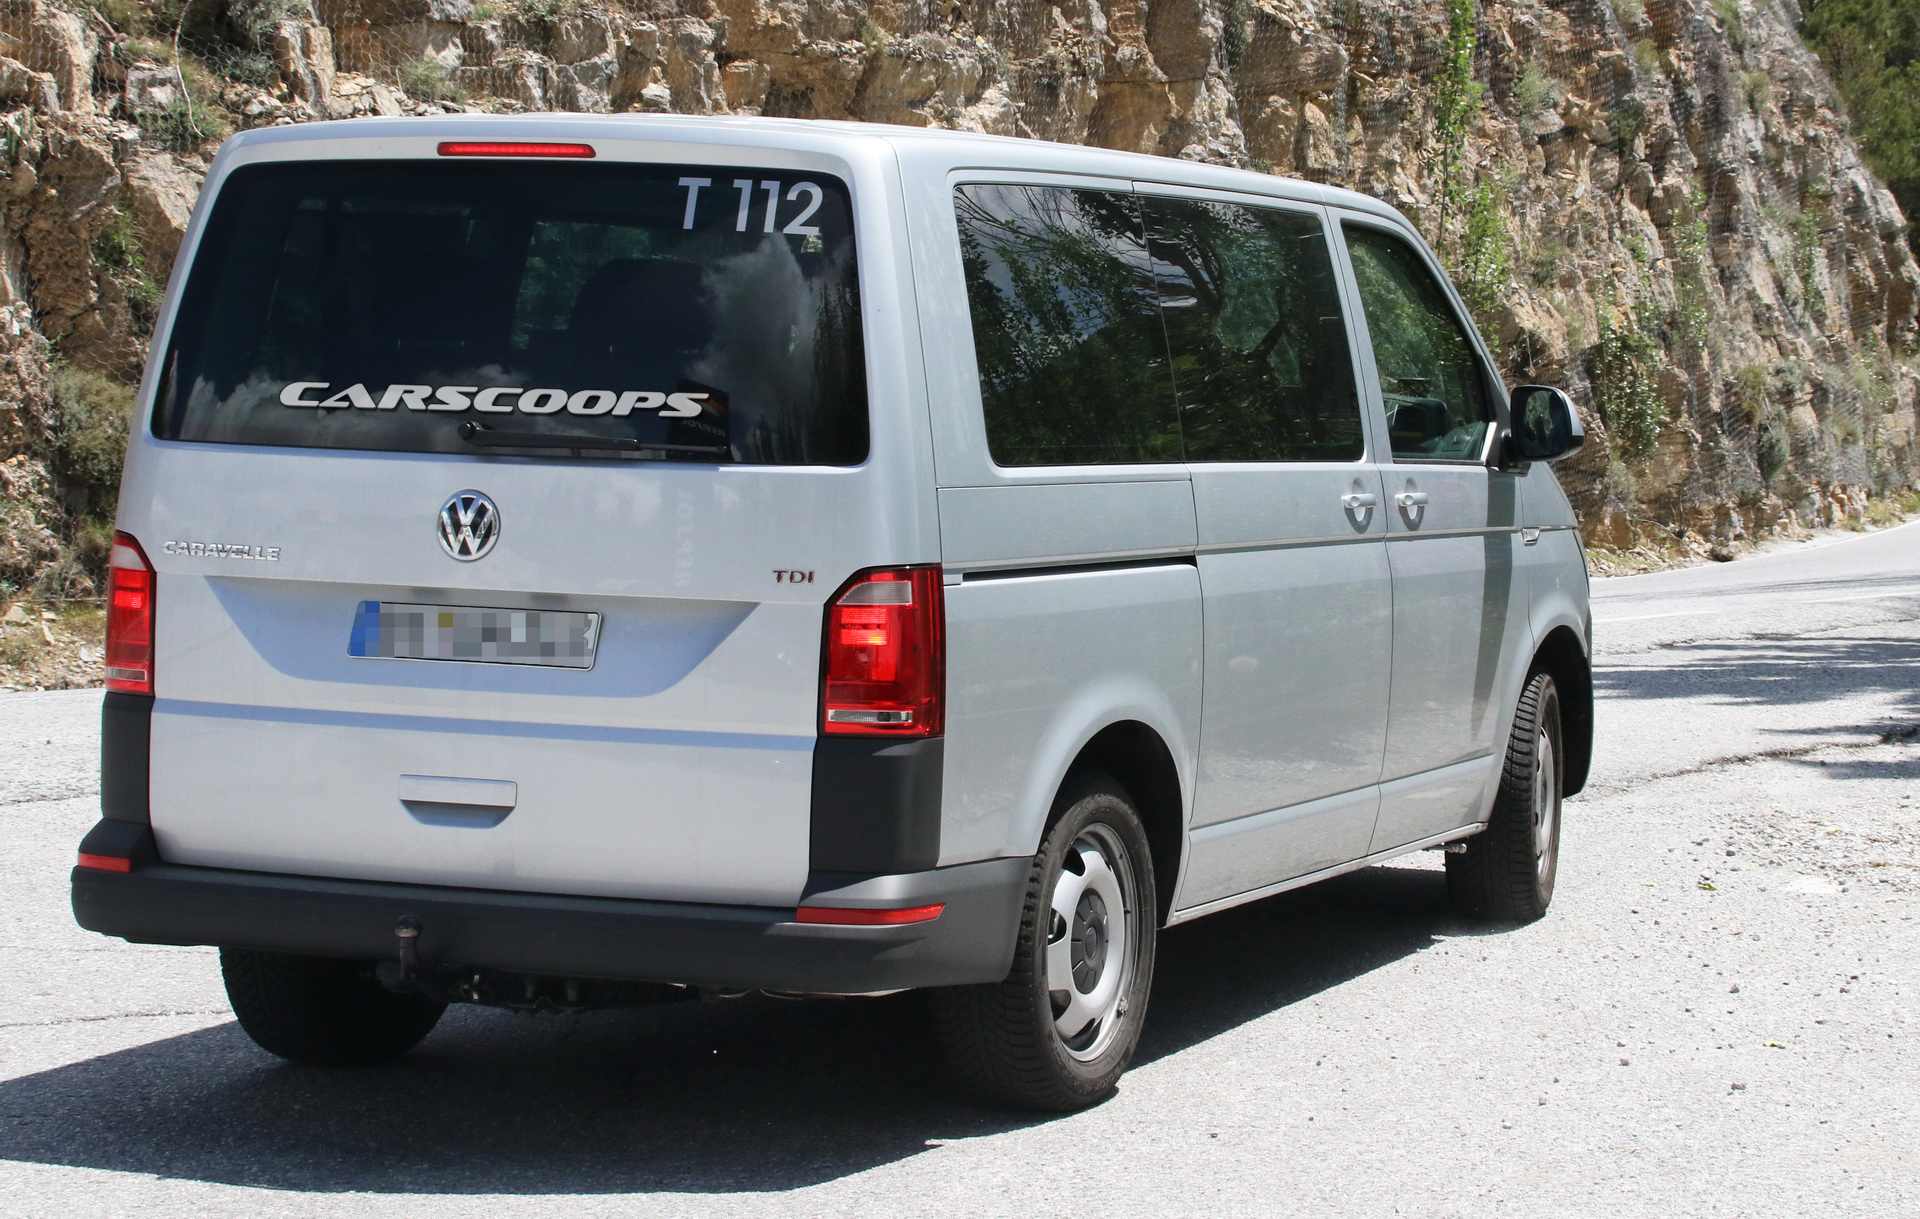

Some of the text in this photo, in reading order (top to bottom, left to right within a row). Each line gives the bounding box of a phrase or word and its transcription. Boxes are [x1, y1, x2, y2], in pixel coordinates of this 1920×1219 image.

[677, 176, 824, 236] T 112
[162, 540, 281, 562] CARAVELLE
[772, 569, 816, 585] TDI
